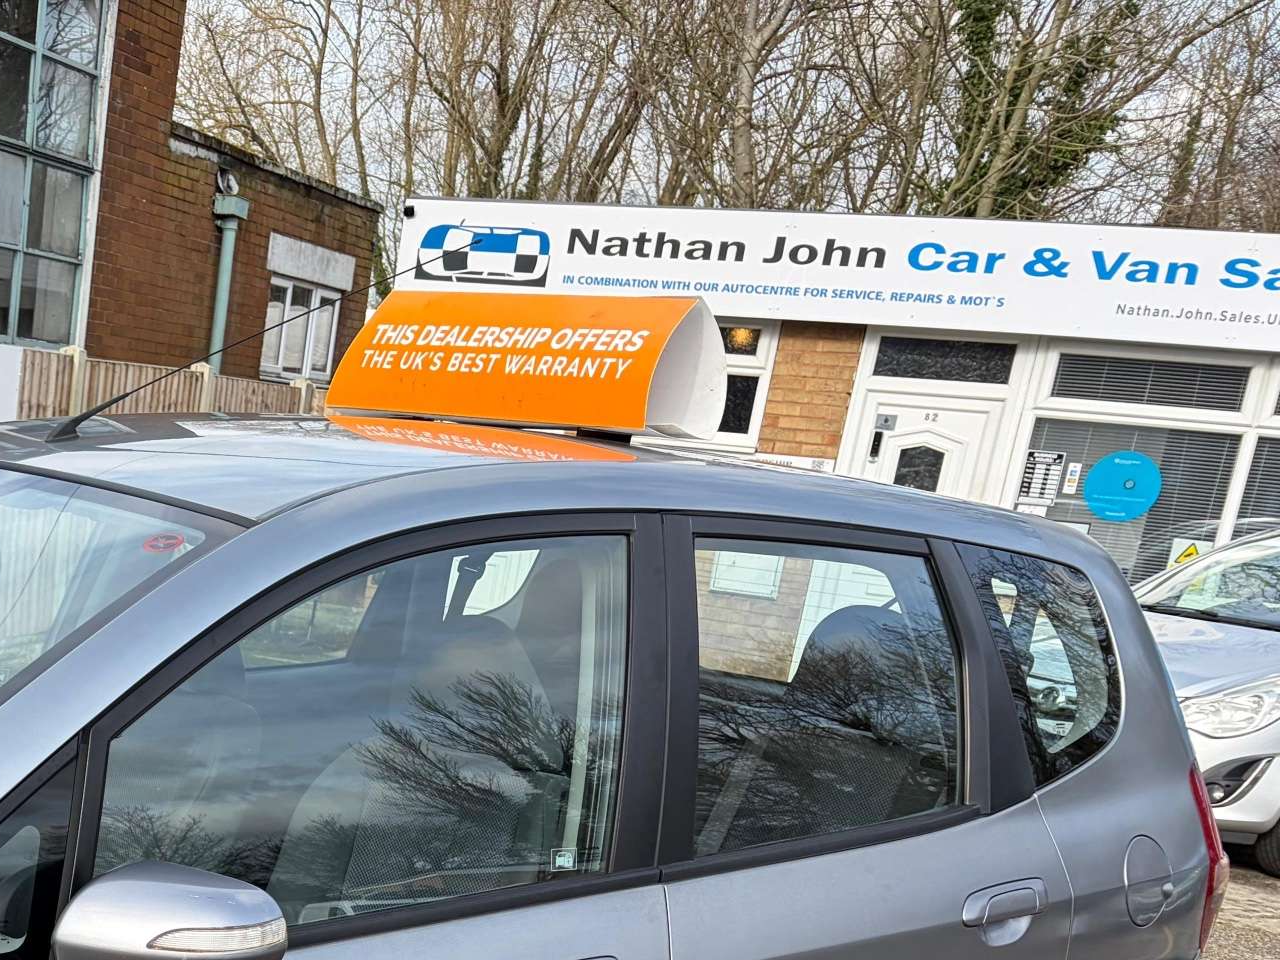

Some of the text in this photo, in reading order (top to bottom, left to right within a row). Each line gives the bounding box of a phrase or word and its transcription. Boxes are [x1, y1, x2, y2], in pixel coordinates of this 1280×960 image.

[566, 228, 746, 262] Nathan
[762, 236, 887, 268] John
[907, 242, 1007, 274] Car
[1023, 248, 1070, 278] &
[1091, 250, 1199, 285] Van
[563, 275, 574, 285] IN
[577, 276, 658, 289] COMBINATION
[661, 280, 691, 291] WITH
[694, 281, 719, 293] OUR
[721, 283, 801, 297] AUTOCENTRE
[803, 287, 828, 299] FOR
[831, 288, 886, 302] SERVICE,
[890, 291, 943, 304] REPAIRS
[947, 294, 957, 305] &
[1115, 303, 1280, 326] Nathan.John.Sales.U
[371, 324, 650, 352] THIS DEALERSHIP OFFERS
[361, 349, 633, 380] THE UK'S BEST WARRANTY
